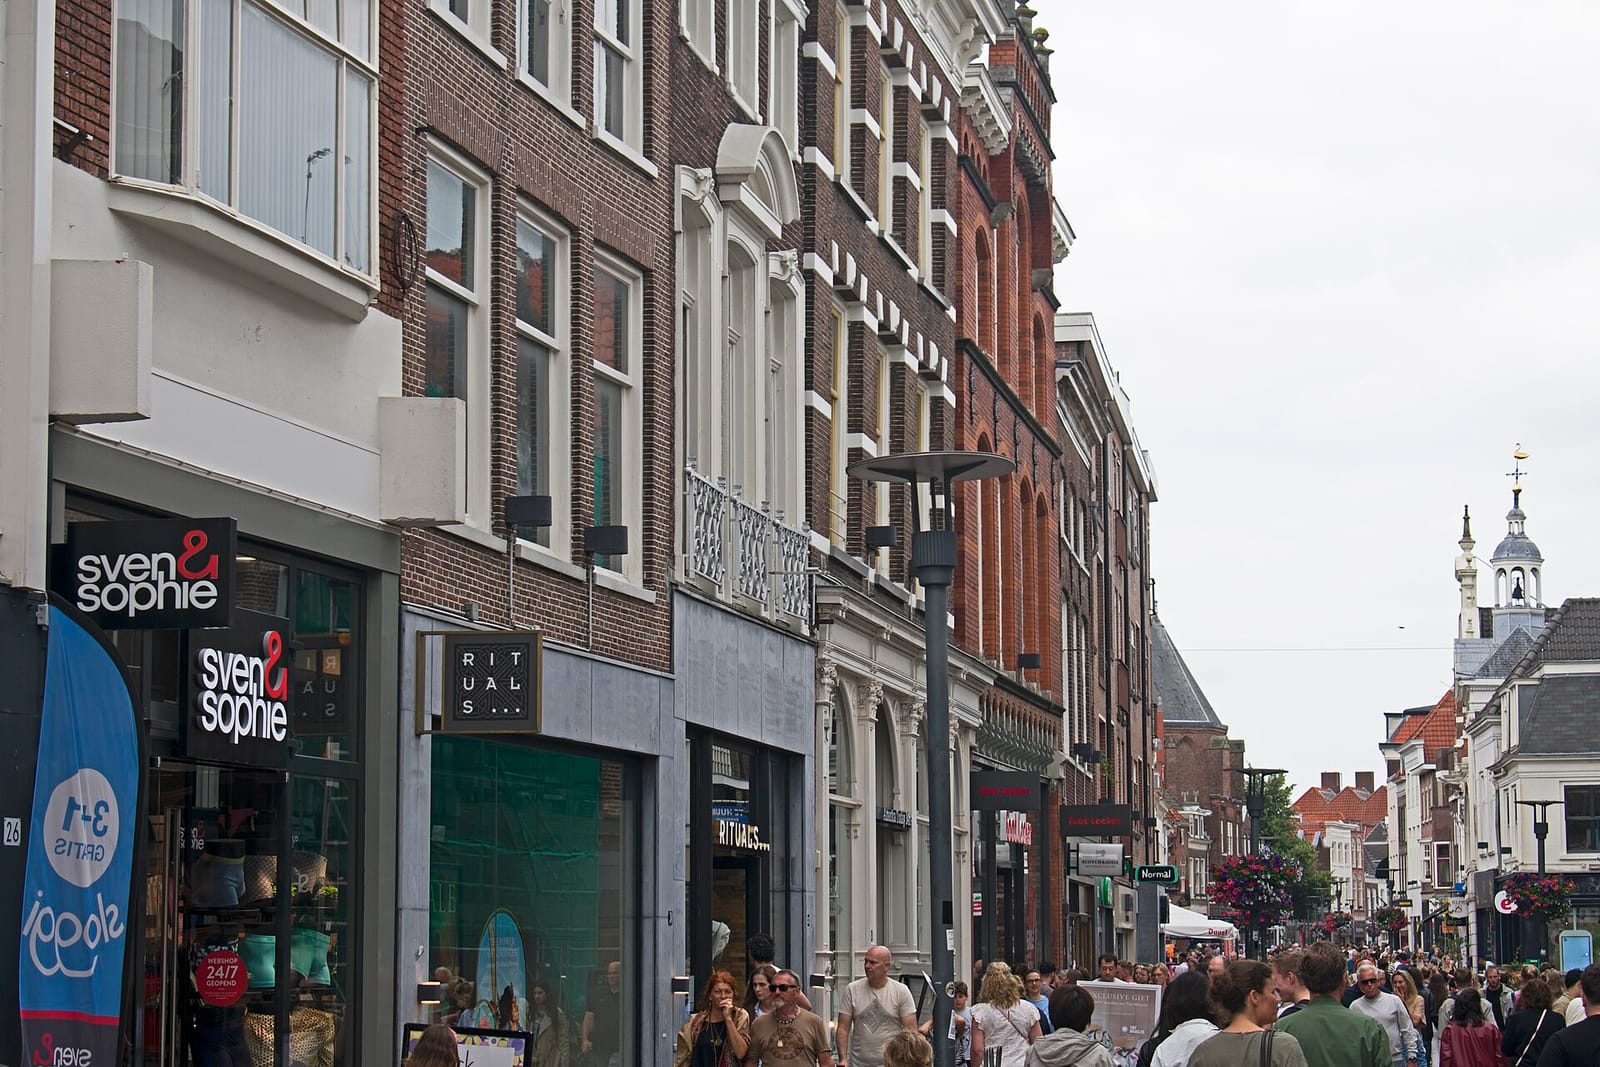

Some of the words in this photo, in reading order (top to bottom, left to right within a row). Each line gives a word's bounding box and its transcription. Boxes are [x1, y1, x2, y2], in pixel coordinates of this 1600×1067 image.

[77, 571, 218, 618] sophie
[200, 682, 288, 745] sophie
[6, 821, 20, 843] 26
[1141, 869, 1171, 879] Normal
[207, 957, 239, 965] WEBSHOP
[206, 965, 239, 979] 24/7
